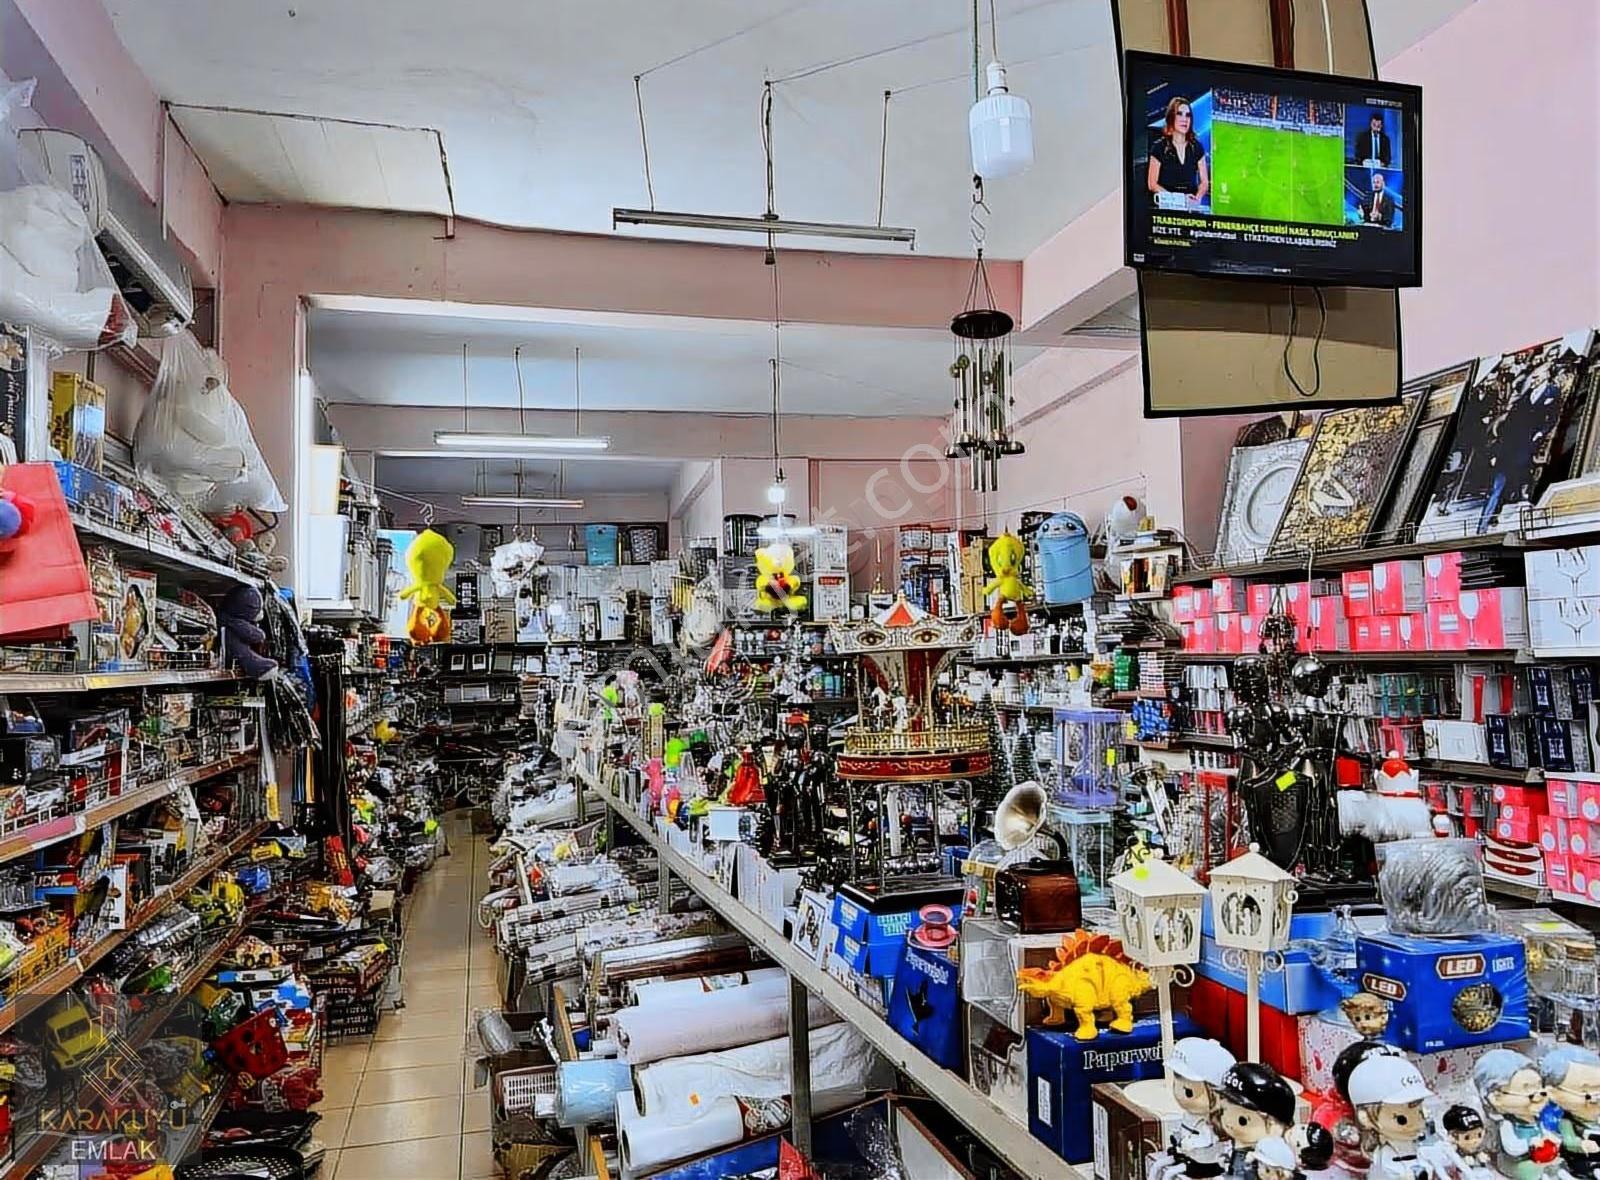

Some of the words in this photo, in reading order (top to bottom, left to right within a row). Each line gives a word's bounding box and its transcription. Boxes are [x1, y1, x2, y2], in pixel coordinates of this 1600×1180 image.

[1152, 215, 1207, 228] TRABZONSPOR
[1447, 958, 1478, 975] LED
[1492, 955, 1515, 973] LIGHTS
[1371, 978, 1397, 996] LED
[1083, 1041, 1164, 1072] Paperwei
